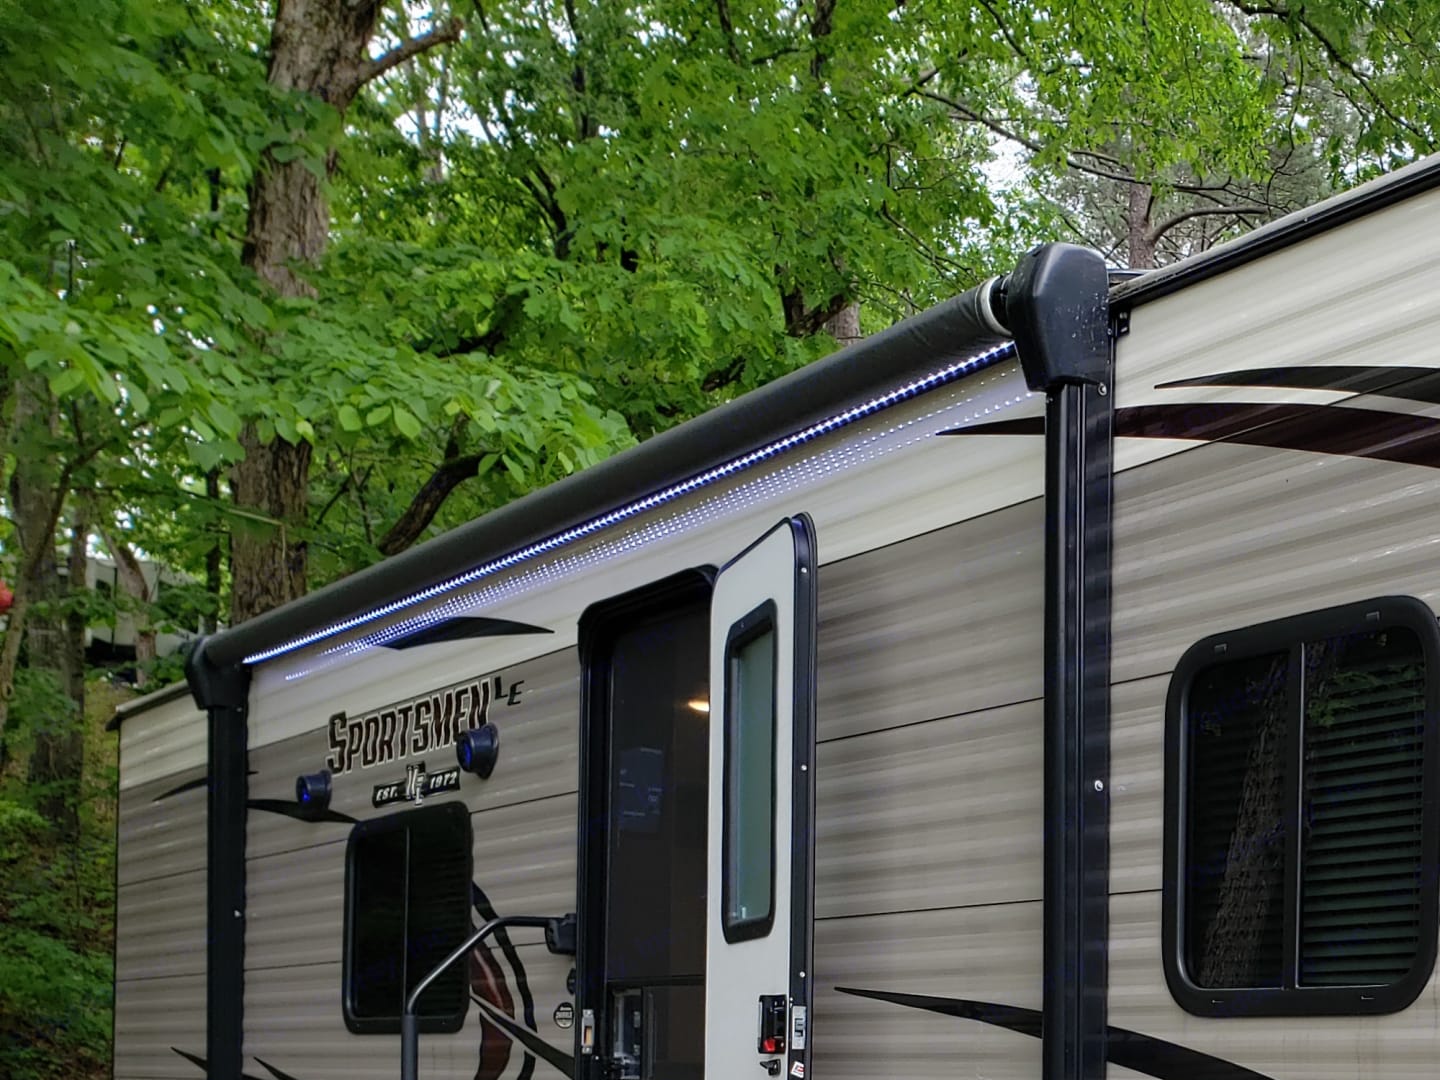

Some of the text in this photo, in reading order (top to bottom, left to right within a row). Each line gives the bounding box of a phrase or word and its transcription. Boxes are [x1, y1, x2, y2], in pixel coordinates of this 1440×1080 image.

[325, 676, 525, 778] SPORTSMEN LE
[375, 785, 399, 802] EST.
[429, 771, 459, 790] 1972
